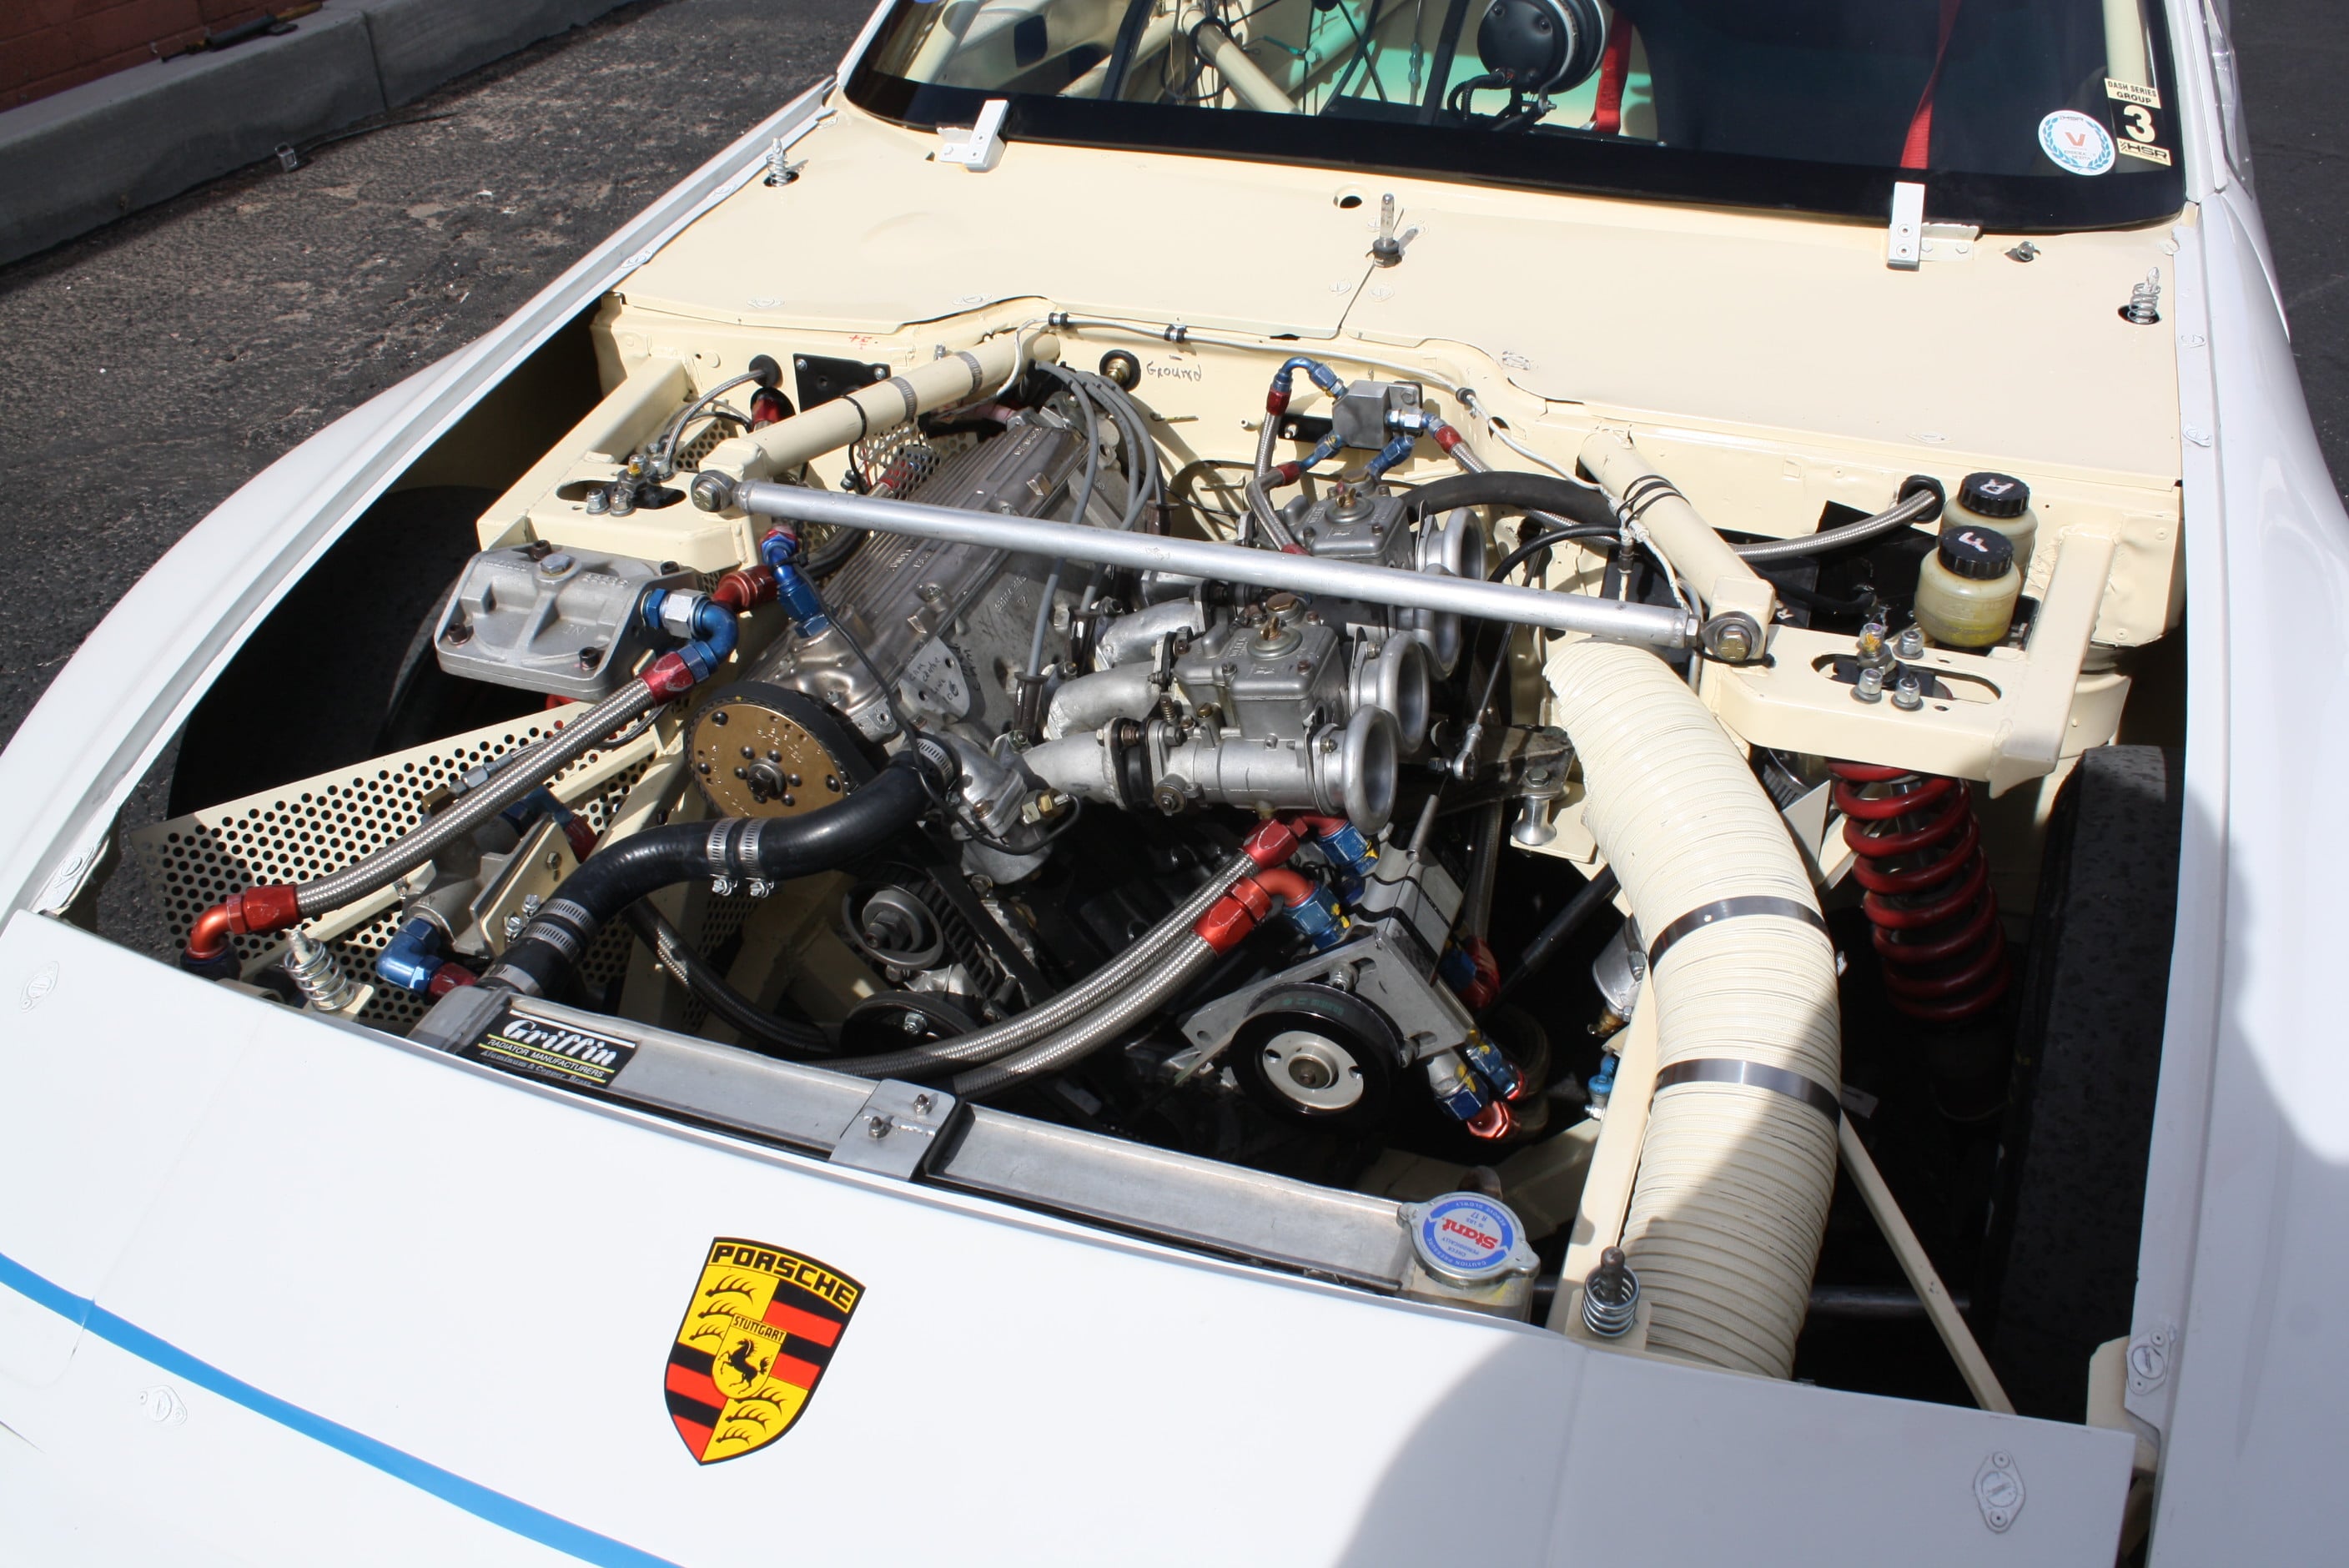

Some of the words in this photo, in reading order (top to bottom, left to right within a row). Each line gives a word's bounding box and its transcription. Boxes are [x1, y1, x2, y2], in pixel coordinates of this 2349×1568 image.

[2108, 81, 2128, 91] DASH
[2130, 85, 2157, 98] SERIES
[2116, 91, 2152, 104] GROUP
[2123, 104, 2155, 143] 3
[2065, 132, 2085, 147] V
[2127, 143, 2167, 158] HSR
[1979, 479, 2015, 495] R
[1959, 531, 1989, 552] F
[503, 1019, 616, 1066] Griffin
[480, 1050, 526, 1068] Aluminum
[535, 1065, 566, 1079] Copper
[487, 1038, 530, 1057] RADIATOR
[530, 1049, 606, 1078] MANUFACTURERS
[1454, 1259, 1486, 1268] CAUTION
[711, 1244, 856, 1310] PORSCHE
[732, 1314, 786, 1343] STUTTGART
